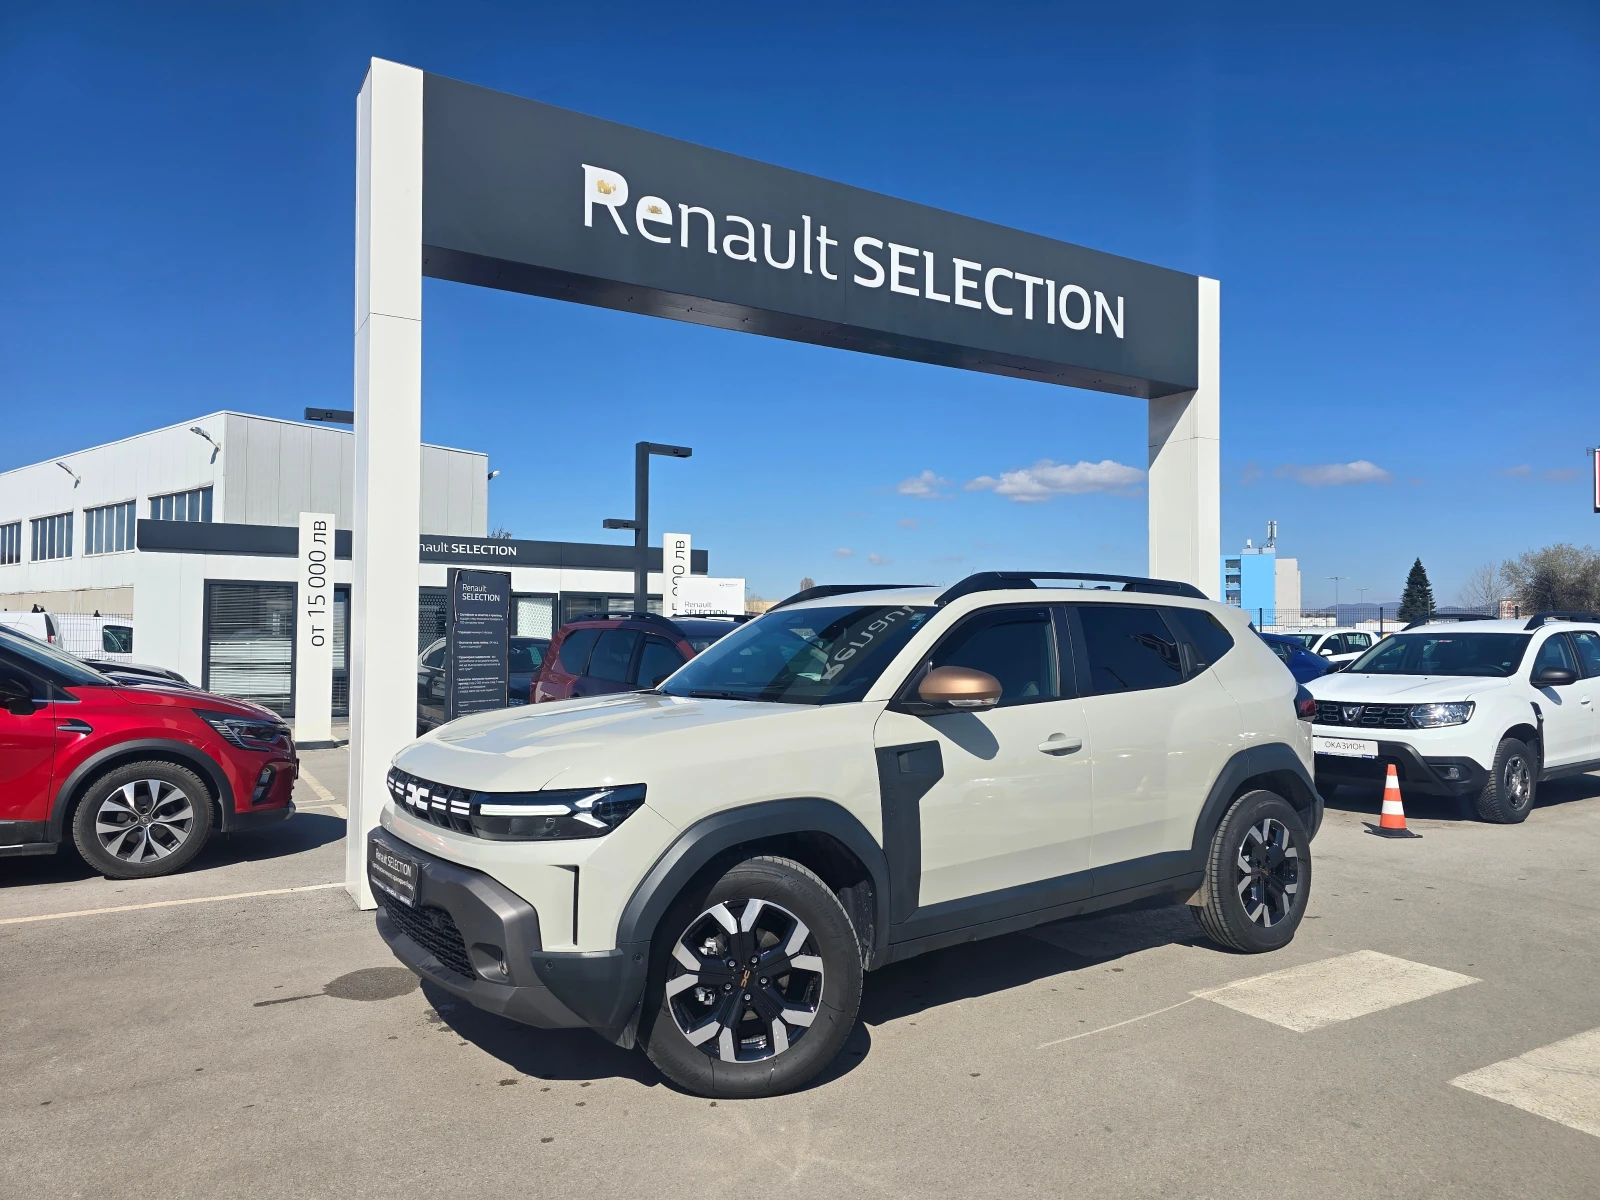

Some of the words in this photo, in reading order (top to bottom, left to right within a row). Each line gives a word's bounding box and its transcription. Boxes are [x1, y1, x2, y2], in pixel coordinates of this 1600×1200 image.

[581, 163, 838, 281] Renault
[853, 235, 1125, 340] SELECTION
[451, 543, 517, 556] SELECTION
[307, 550, 327, 588] 000
[462, 583, 487, 593] Renault
[462, 592, 500, 602] SELECTION
[307, 594, 326, 617] 15
[684, 600, 712, 608] Renault
[1324, 740, 1366, 750] ОКАЗИОН
[387, 855, 412, 877] SELECTION
